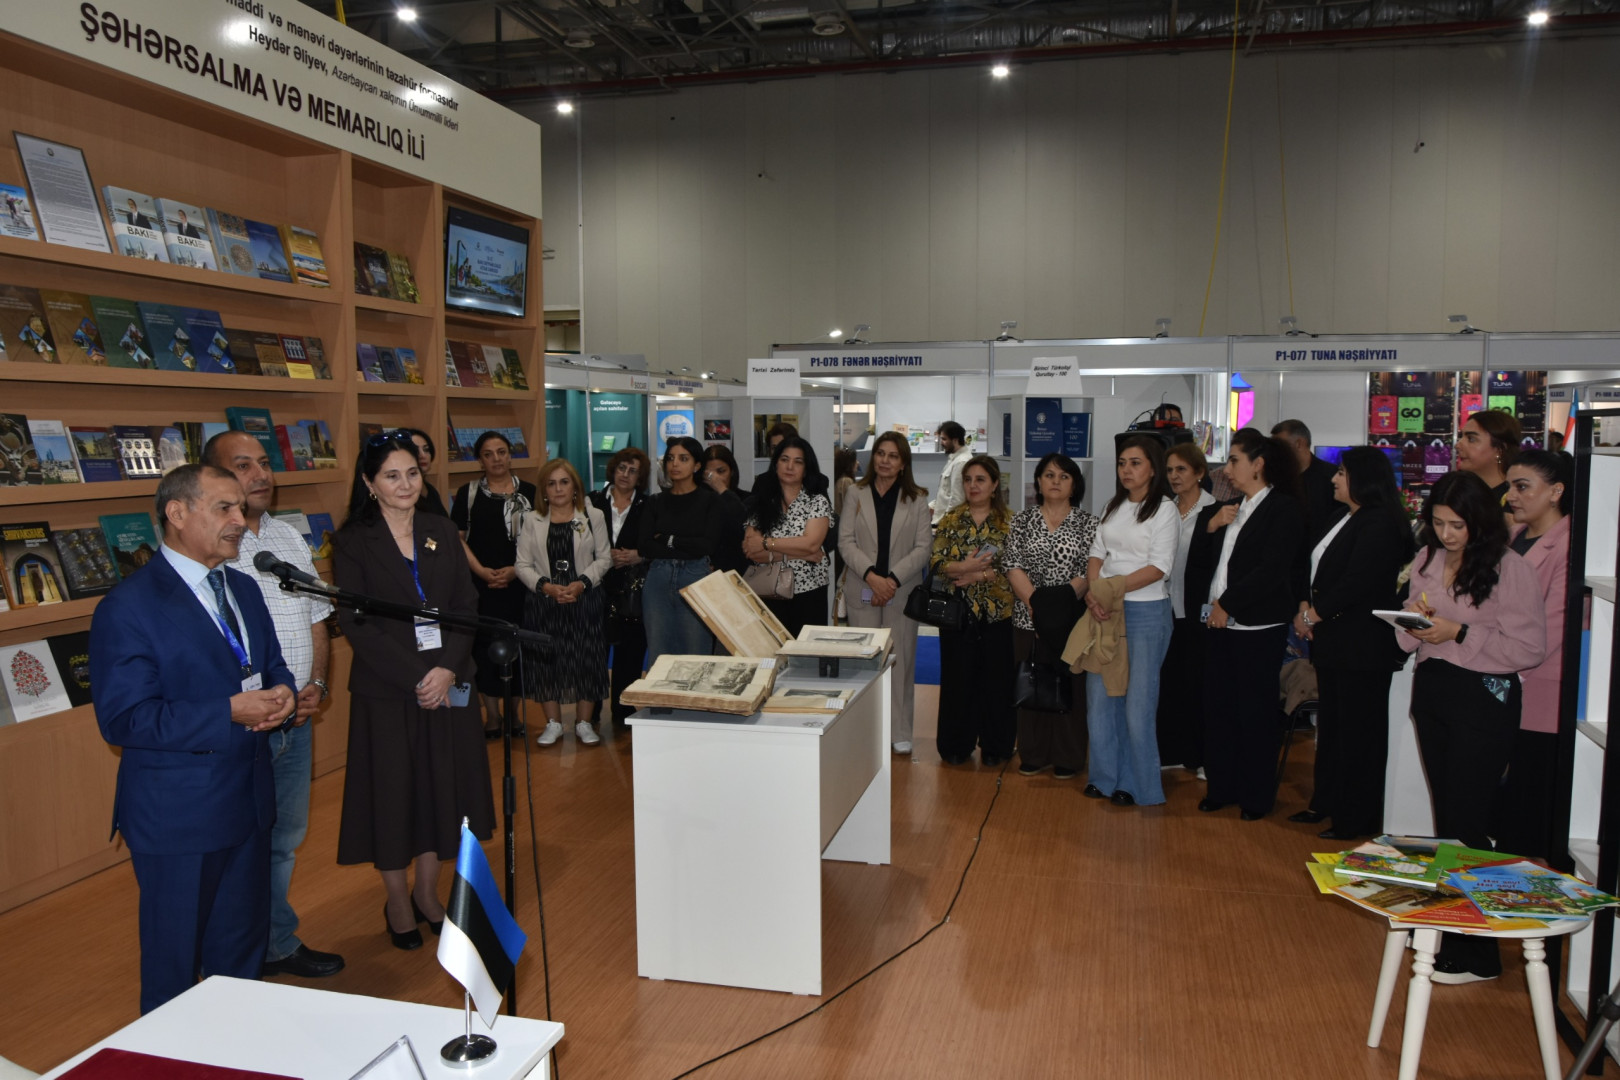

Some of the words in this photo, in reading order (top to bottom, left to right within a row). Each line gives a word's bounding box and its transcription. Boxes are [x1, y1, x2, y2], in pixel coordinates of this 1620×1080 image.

[269, 11, 283, 27] və
[287, 20, 325, 48] mənəvi
[328, 39, 384, 76] dəyərlərinin
[386, 67, 417, 91] təzahür
[80, 2, 268, 101] ŞƏHƏRSALMA
[272, 78, 302, 112] VƏ
[308, 93, 403, 154] MEMARLIQ
[407, 129, 425, 161] İLİ
[249, 25, 291, 56] Heydər
[293, 45, 328, 76] Əliyev,
[332, 65, 378, 96] Azərbaycan
[379, 88, 407, 109] xalqının
[443, 115, 459, 131] lideri
[127, 226, 150, 239] BAKI
[177, 235, 198, 248] BAKI
[810, 357, 839, 367] P1-078
[842, 356, 870, 367] FƏNƏR
[871, 354, 922, 368] NƏŞRİYYATI
[1275, 350, 1307, 361] P1-077
[1310, 349, 1337, 361] TUNA
[1338, 348, 1397, 362] NƏŞRİYYATI
[1400, 407, 1422, 418] GO
